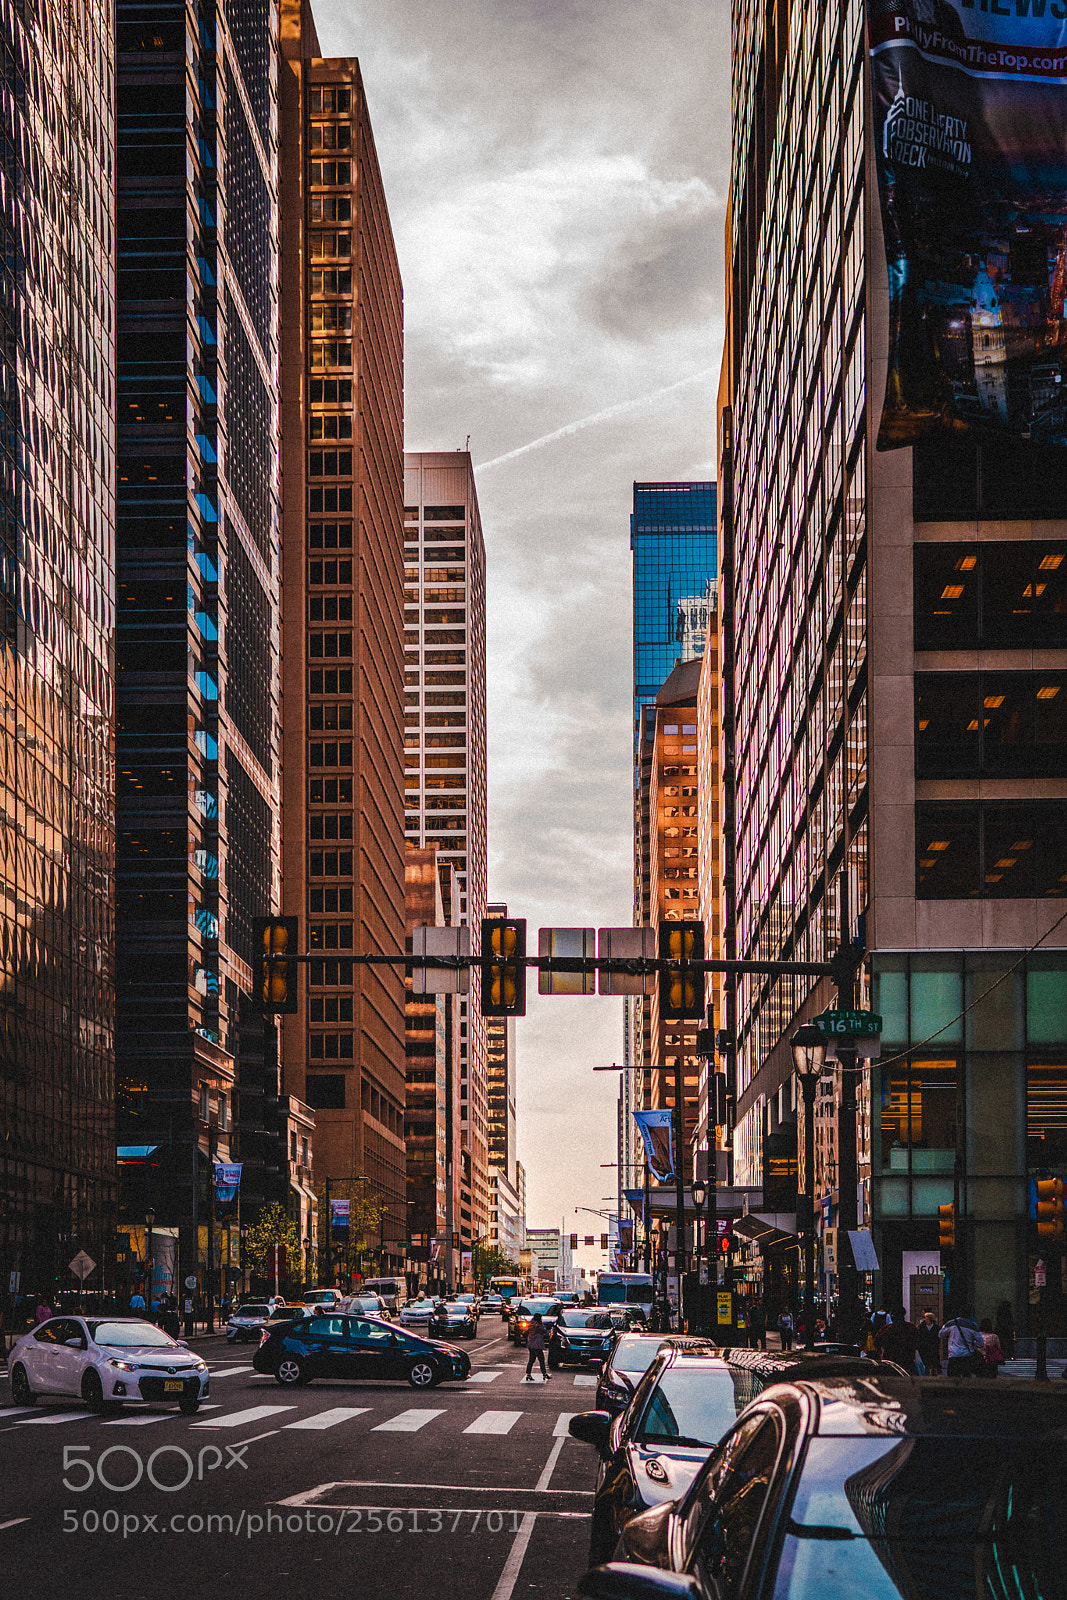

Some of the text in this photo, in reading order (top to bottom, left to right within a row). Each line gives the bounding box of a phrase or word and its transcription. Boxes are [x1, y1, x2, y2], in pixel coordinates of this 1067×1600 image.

[905, 96, 967, 140] ONE LIERTY
[895, 140, 927, 169] DECK
[896, 117, 971, 164] OBSERVAION
[867, 1022, 879, 1032] ST
[916, 1265, 939, 1276] 1601
